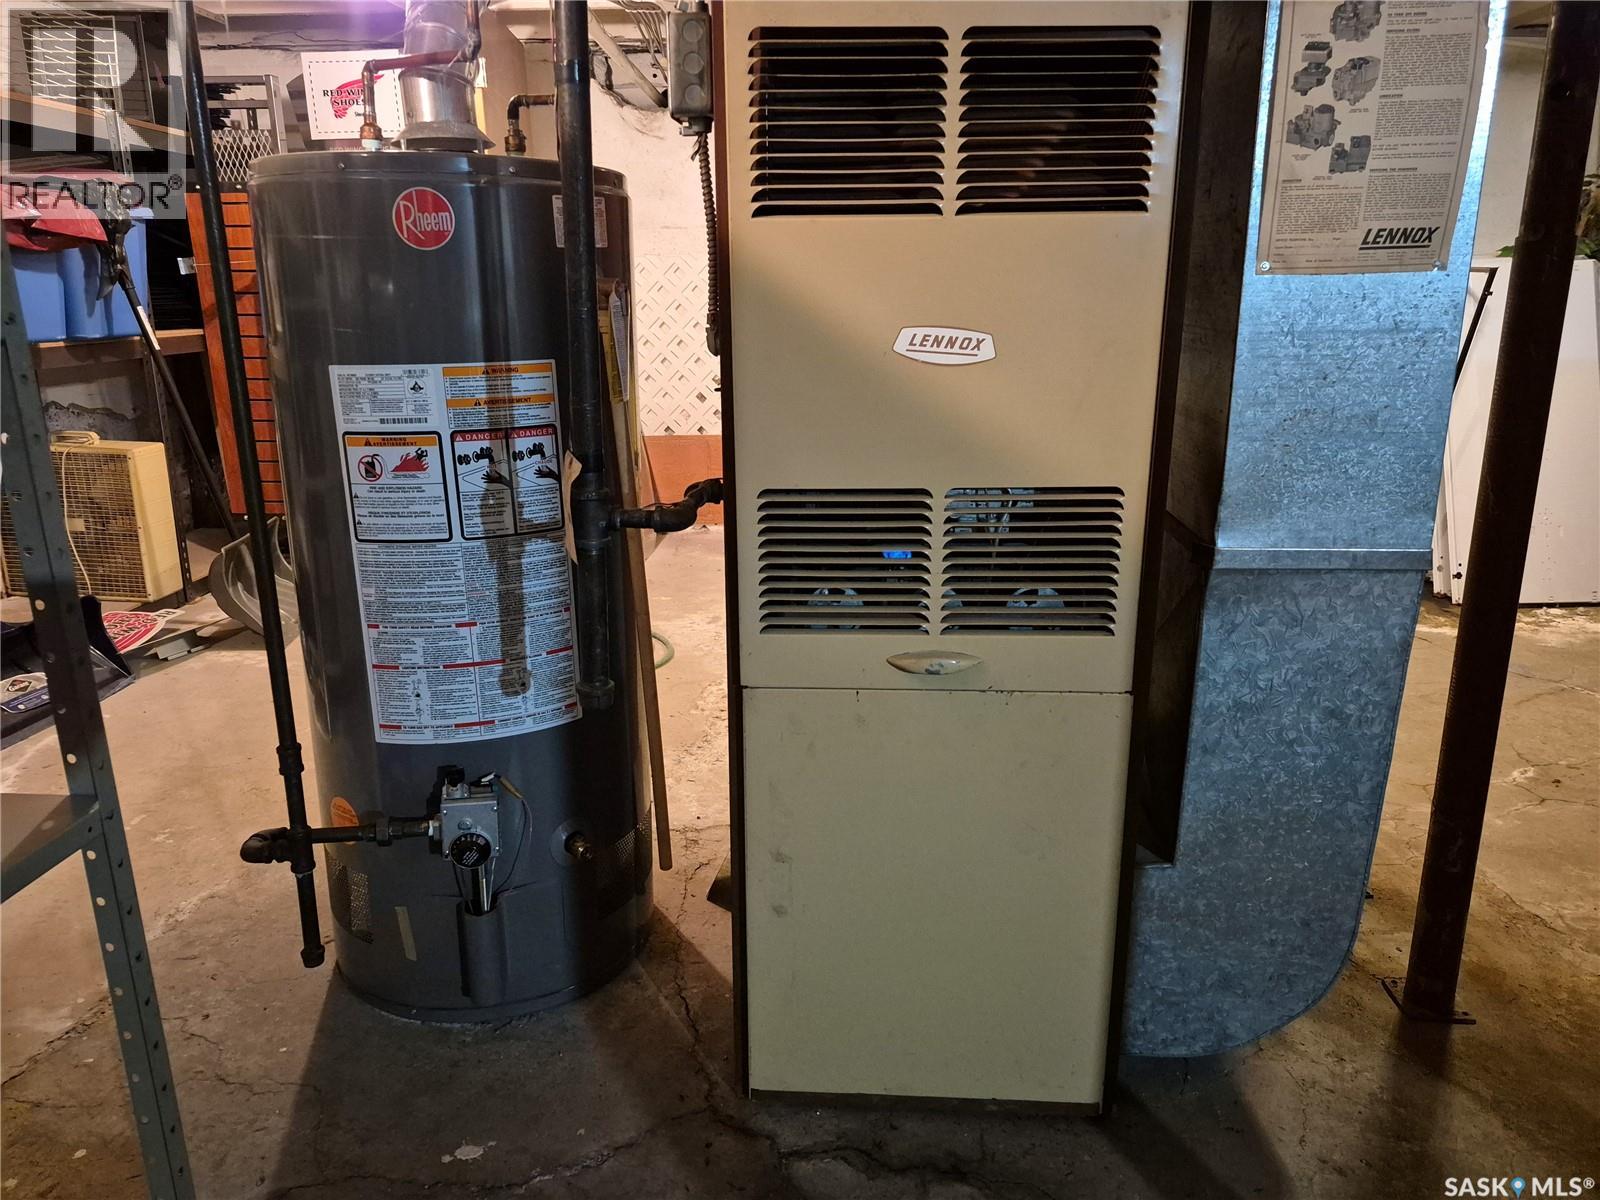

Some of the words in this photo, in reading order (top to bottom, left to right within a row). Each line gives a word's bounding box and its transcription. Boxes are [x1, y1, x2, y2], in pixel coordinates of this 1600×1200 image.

[322, 89, 343, 97] RED
[346, 88, 365, 96] WIN
[400, 190, 452, 240] Rheem
[1360, 226, 1441, 246] LENNOX
[908, 333, 986, 351] LENNOX
[465, 432, 504, 440] DANGER
[520, 428, 553, 437] DANGER
